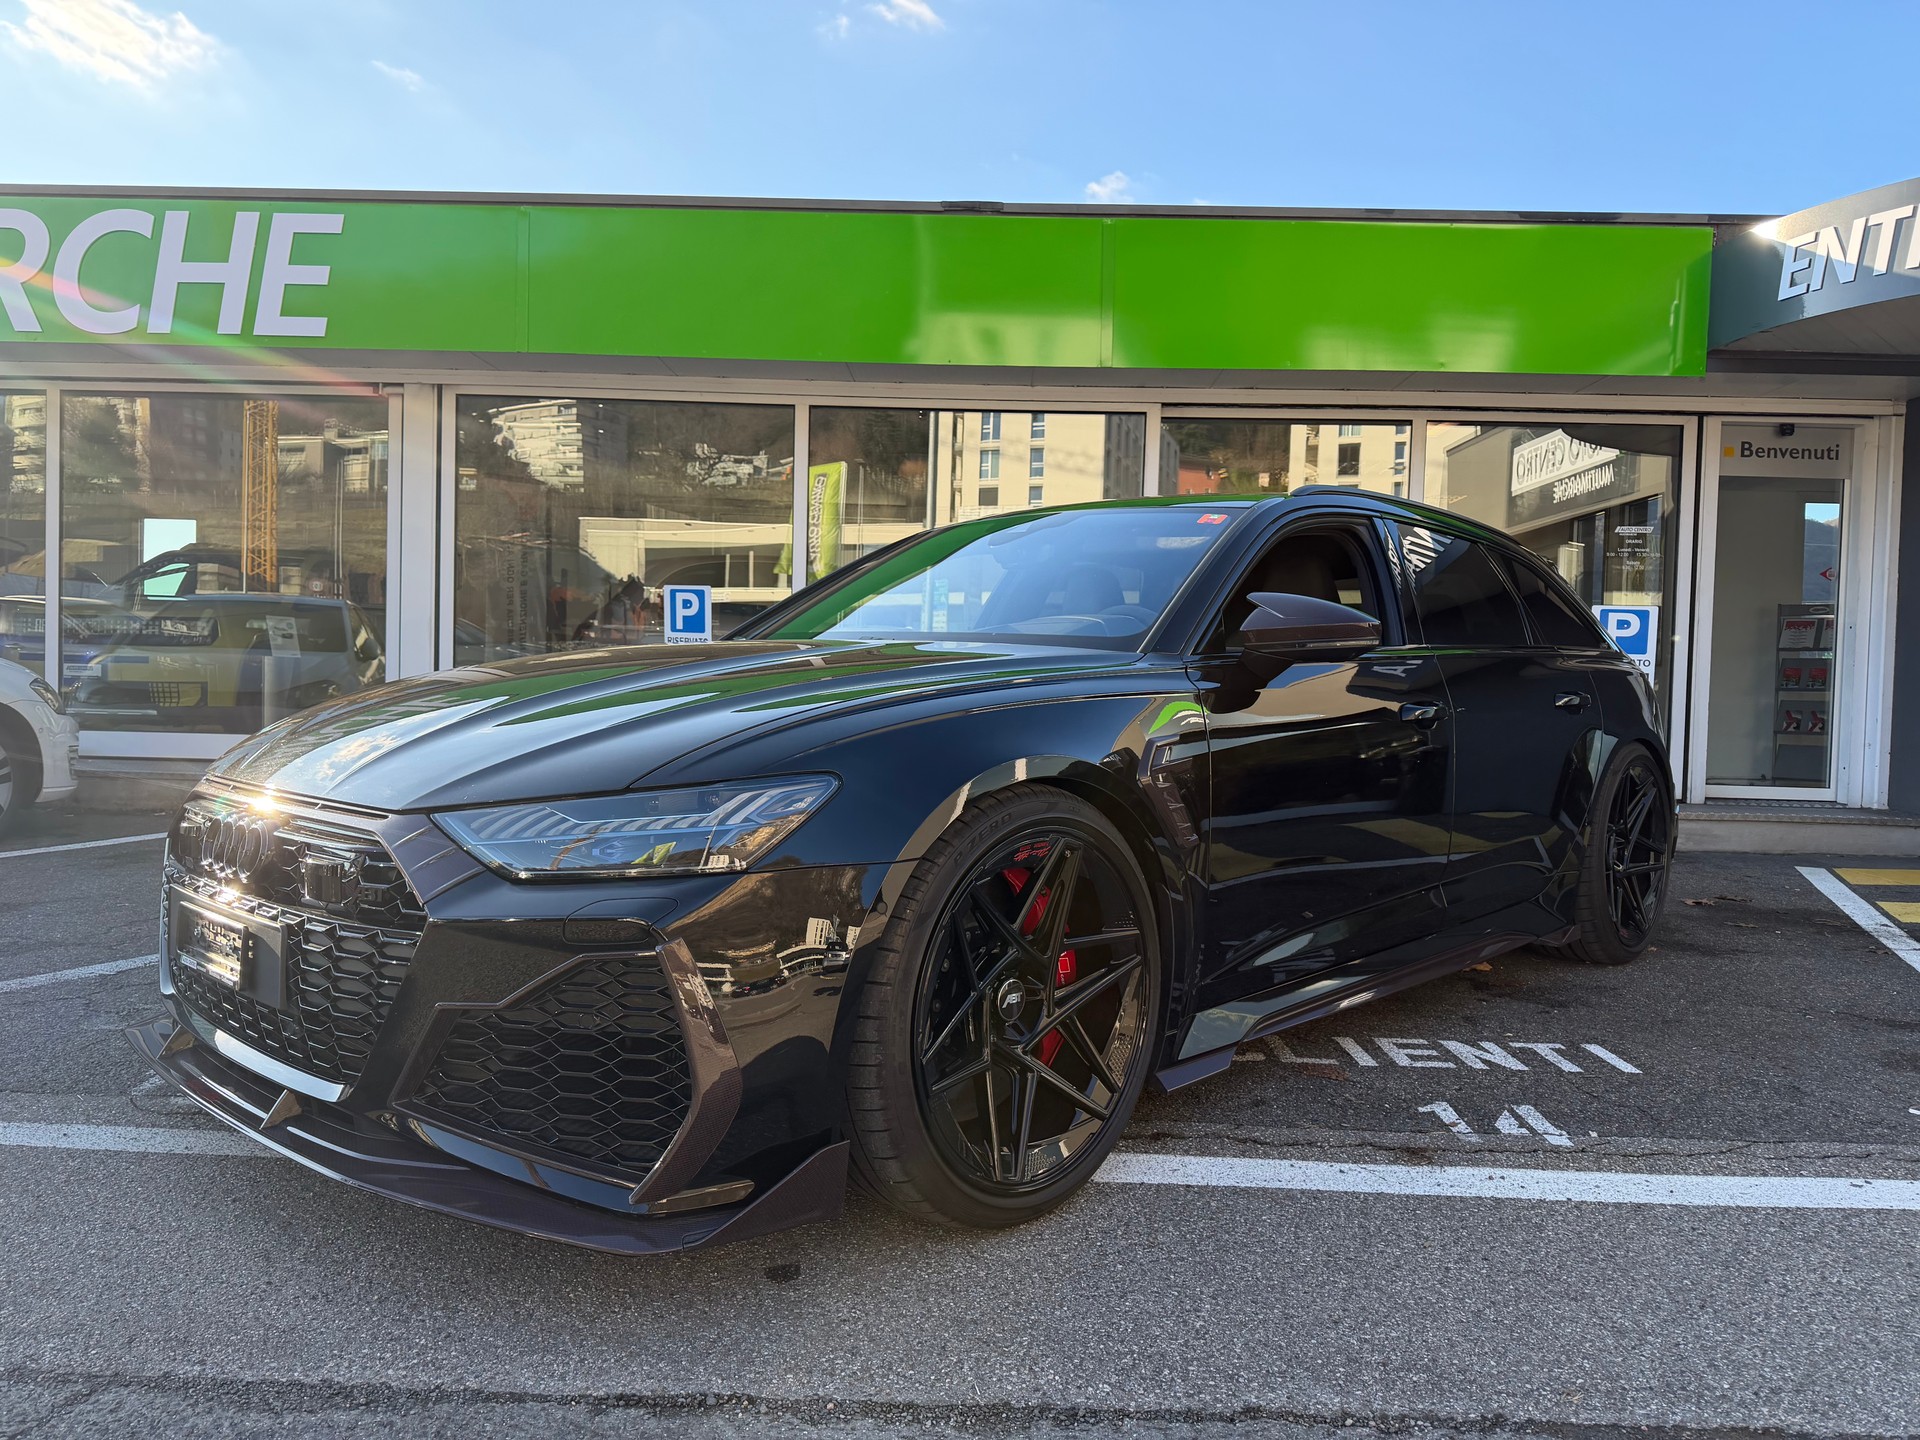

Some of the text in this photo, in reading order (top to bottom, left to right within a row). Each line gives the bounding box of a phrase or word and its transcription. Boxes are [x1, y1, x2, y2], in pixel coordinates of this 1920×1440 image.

[1740, 441, 1840, 460] Benvenuti
[675, 592, 700, 630] P
[1608, 612, 1641, 642] P
[1001, 991, 1023, 1009] ABT
